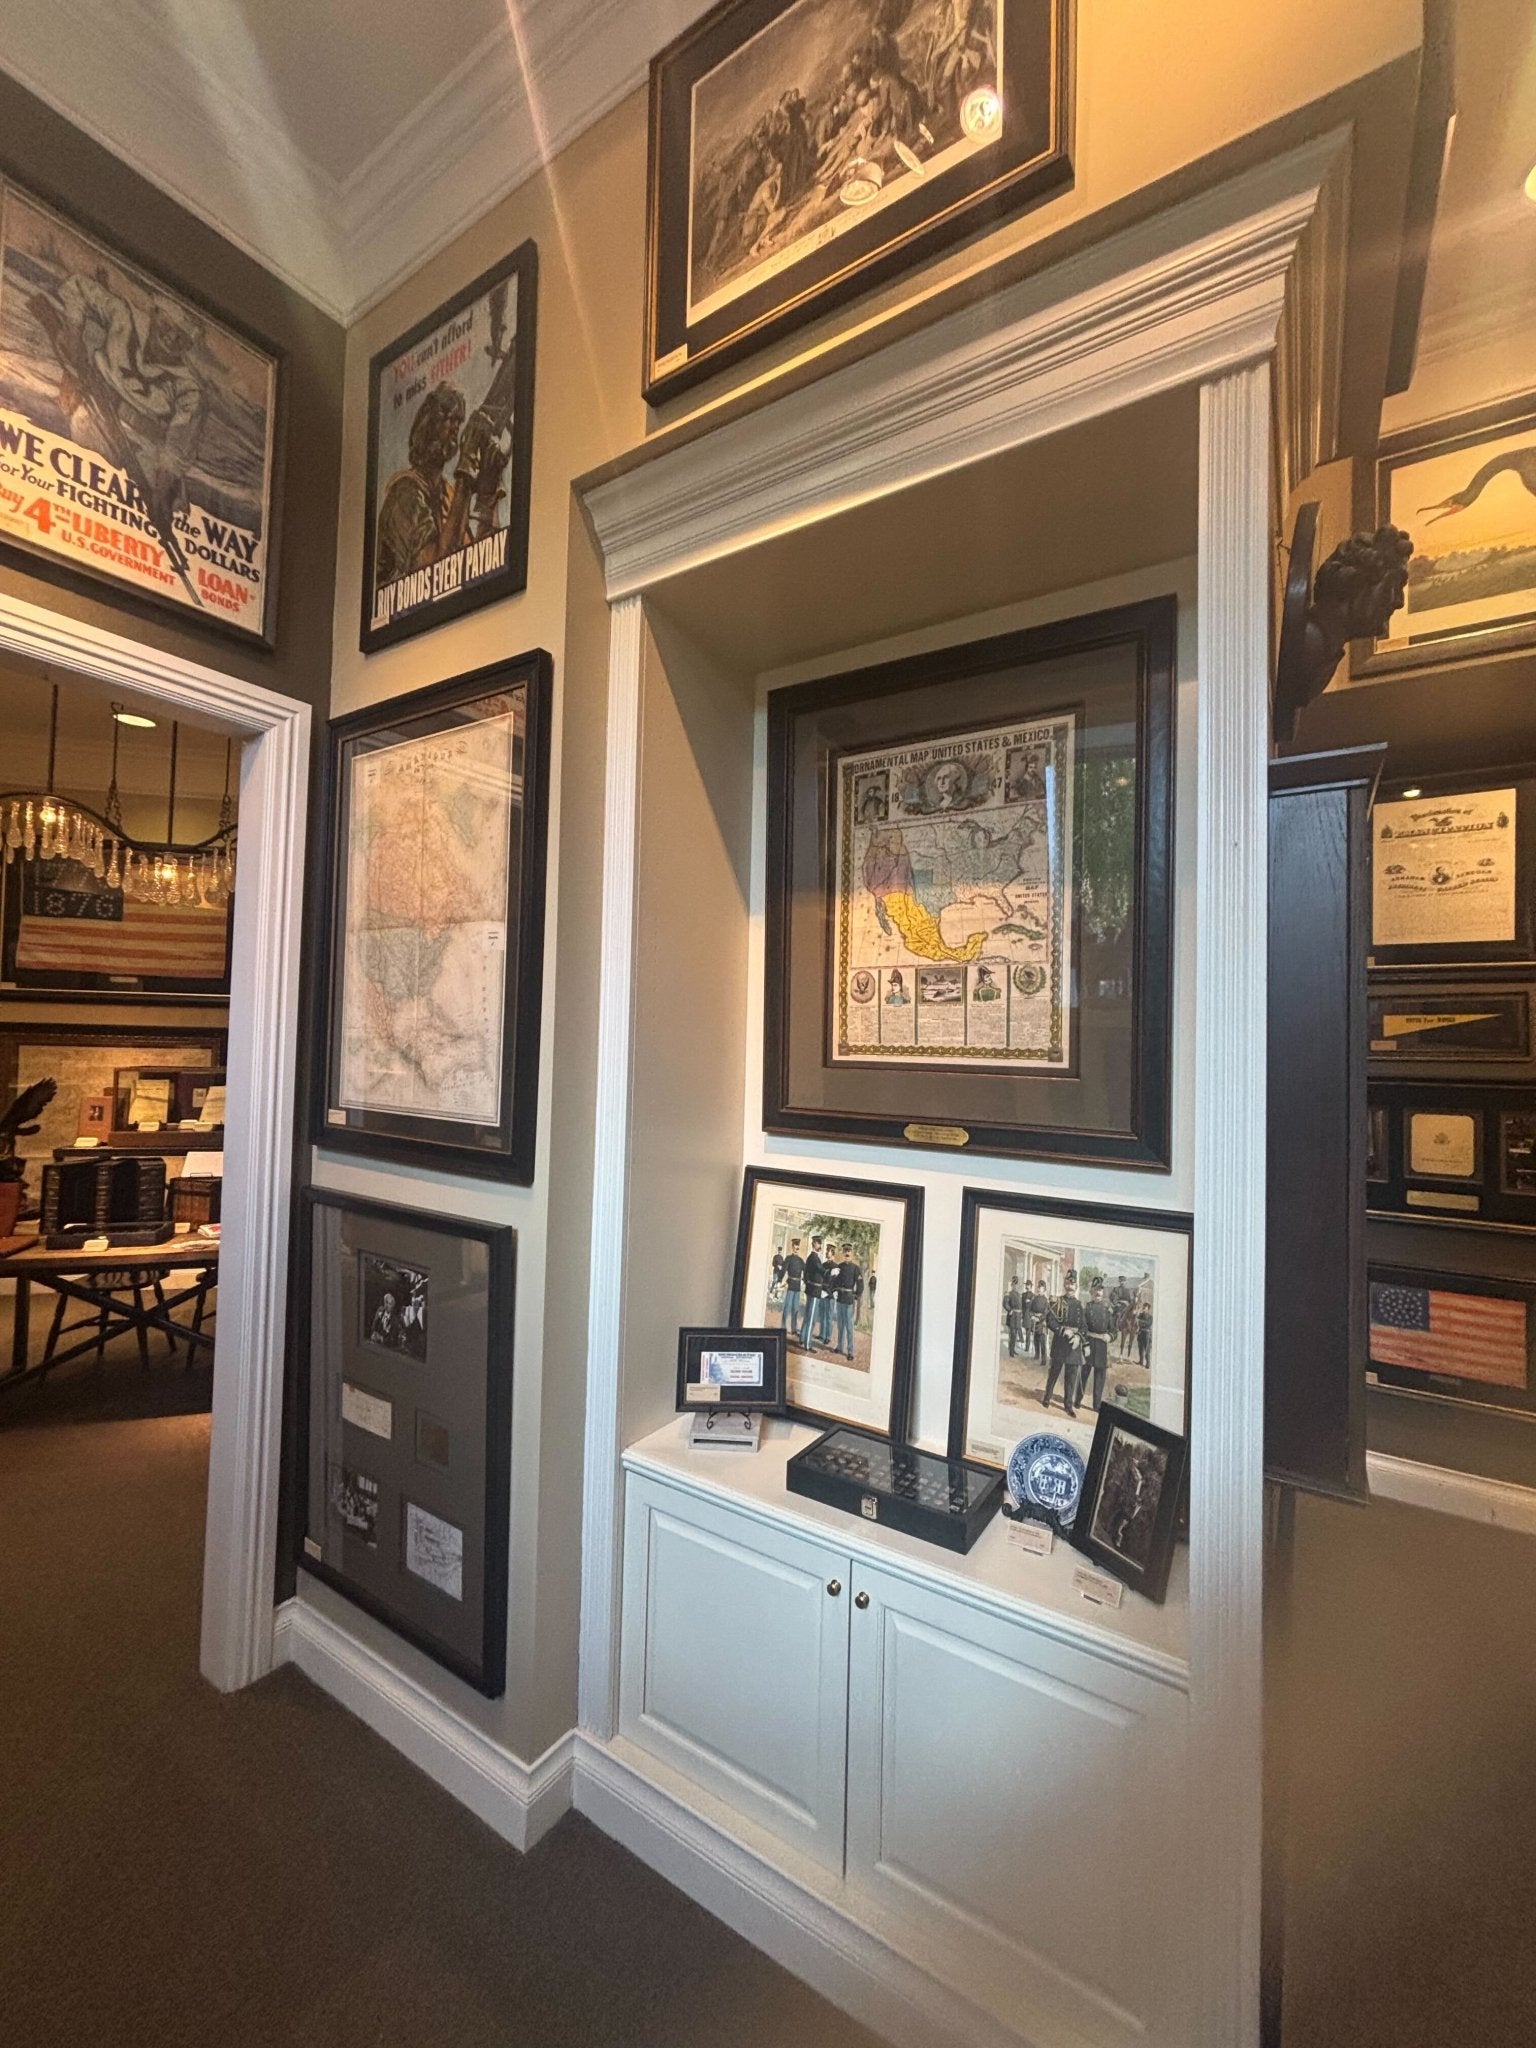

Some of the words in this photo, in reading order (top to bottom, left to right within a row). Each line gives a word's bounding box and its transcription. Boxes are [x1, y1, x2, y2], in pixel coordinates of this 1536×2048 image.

[441, 309, 473, 350] afford
[0, 420, 45, 468] WE
[49, 447, 149, 517] CLEAR
[202, 516, 259, 563] WAY
[0, 453, 20, 476] or
[21, 463, 55, 491] Your
[56, 479, 159, 539] FIGHTING
[184, 537, 261, 583] DOLLARS
[0, 483, 25, 513] uy
[72, 511, 165, 568] LIBERTY
[201, 589, 240, 612] BONDS
[378, 582, 397, 619] BUY
[397, 566, 431, 613] BONDS
[433, 549, 465, 597] EVERY
[465, 529, 508, 582] PAYDAY
[854, 753, 909, 774] ORNAMENTAL
[910, 750, 929, 764] MAP
[932, 744, 963, 760] UNITED
[965, 736, 1000, 754] STATES
[1001, 735, 1012, 747] &
[34, 891, 114, 918] 1876
